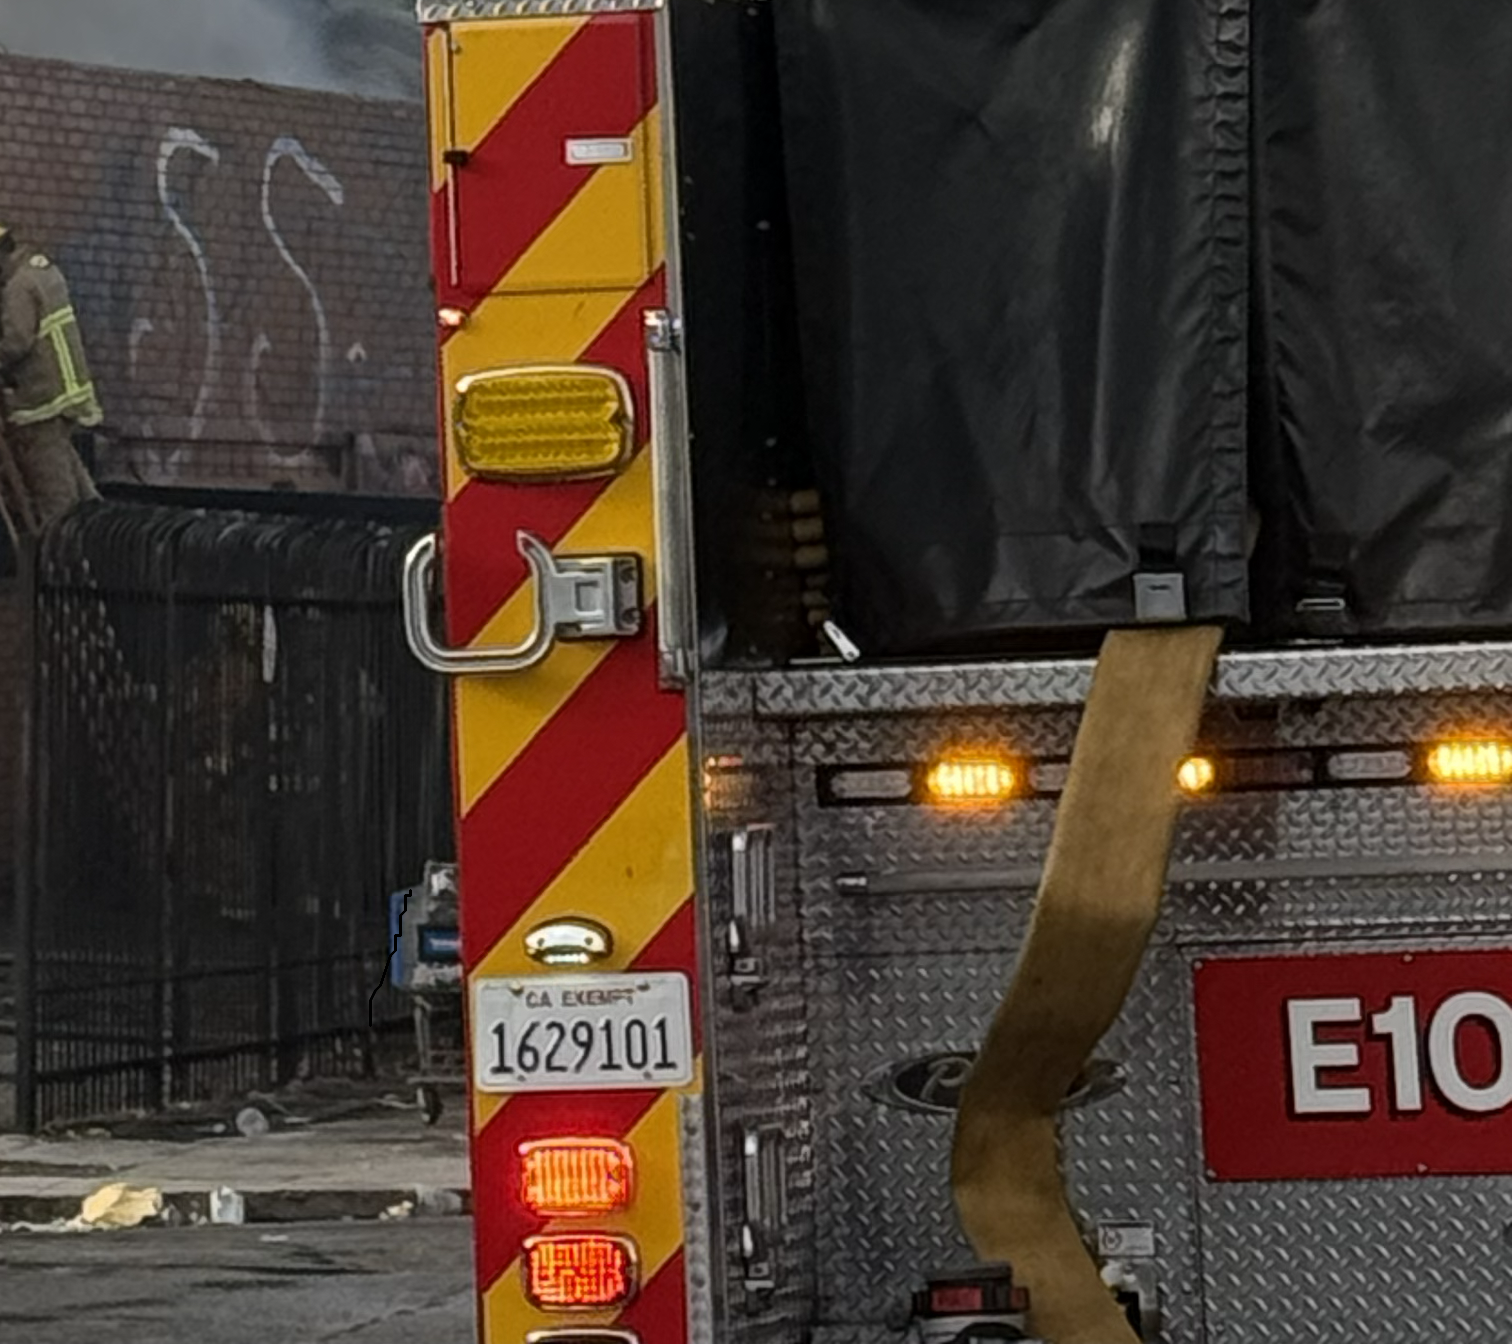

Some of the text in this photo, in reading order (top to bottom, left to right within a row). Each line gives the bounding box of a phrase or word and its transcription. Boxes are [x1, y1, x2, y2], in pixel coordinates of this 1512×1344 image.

[525, 987, 637, 1009] CA EXEMPT
[489, 1016, 678, 1075] 1629101
